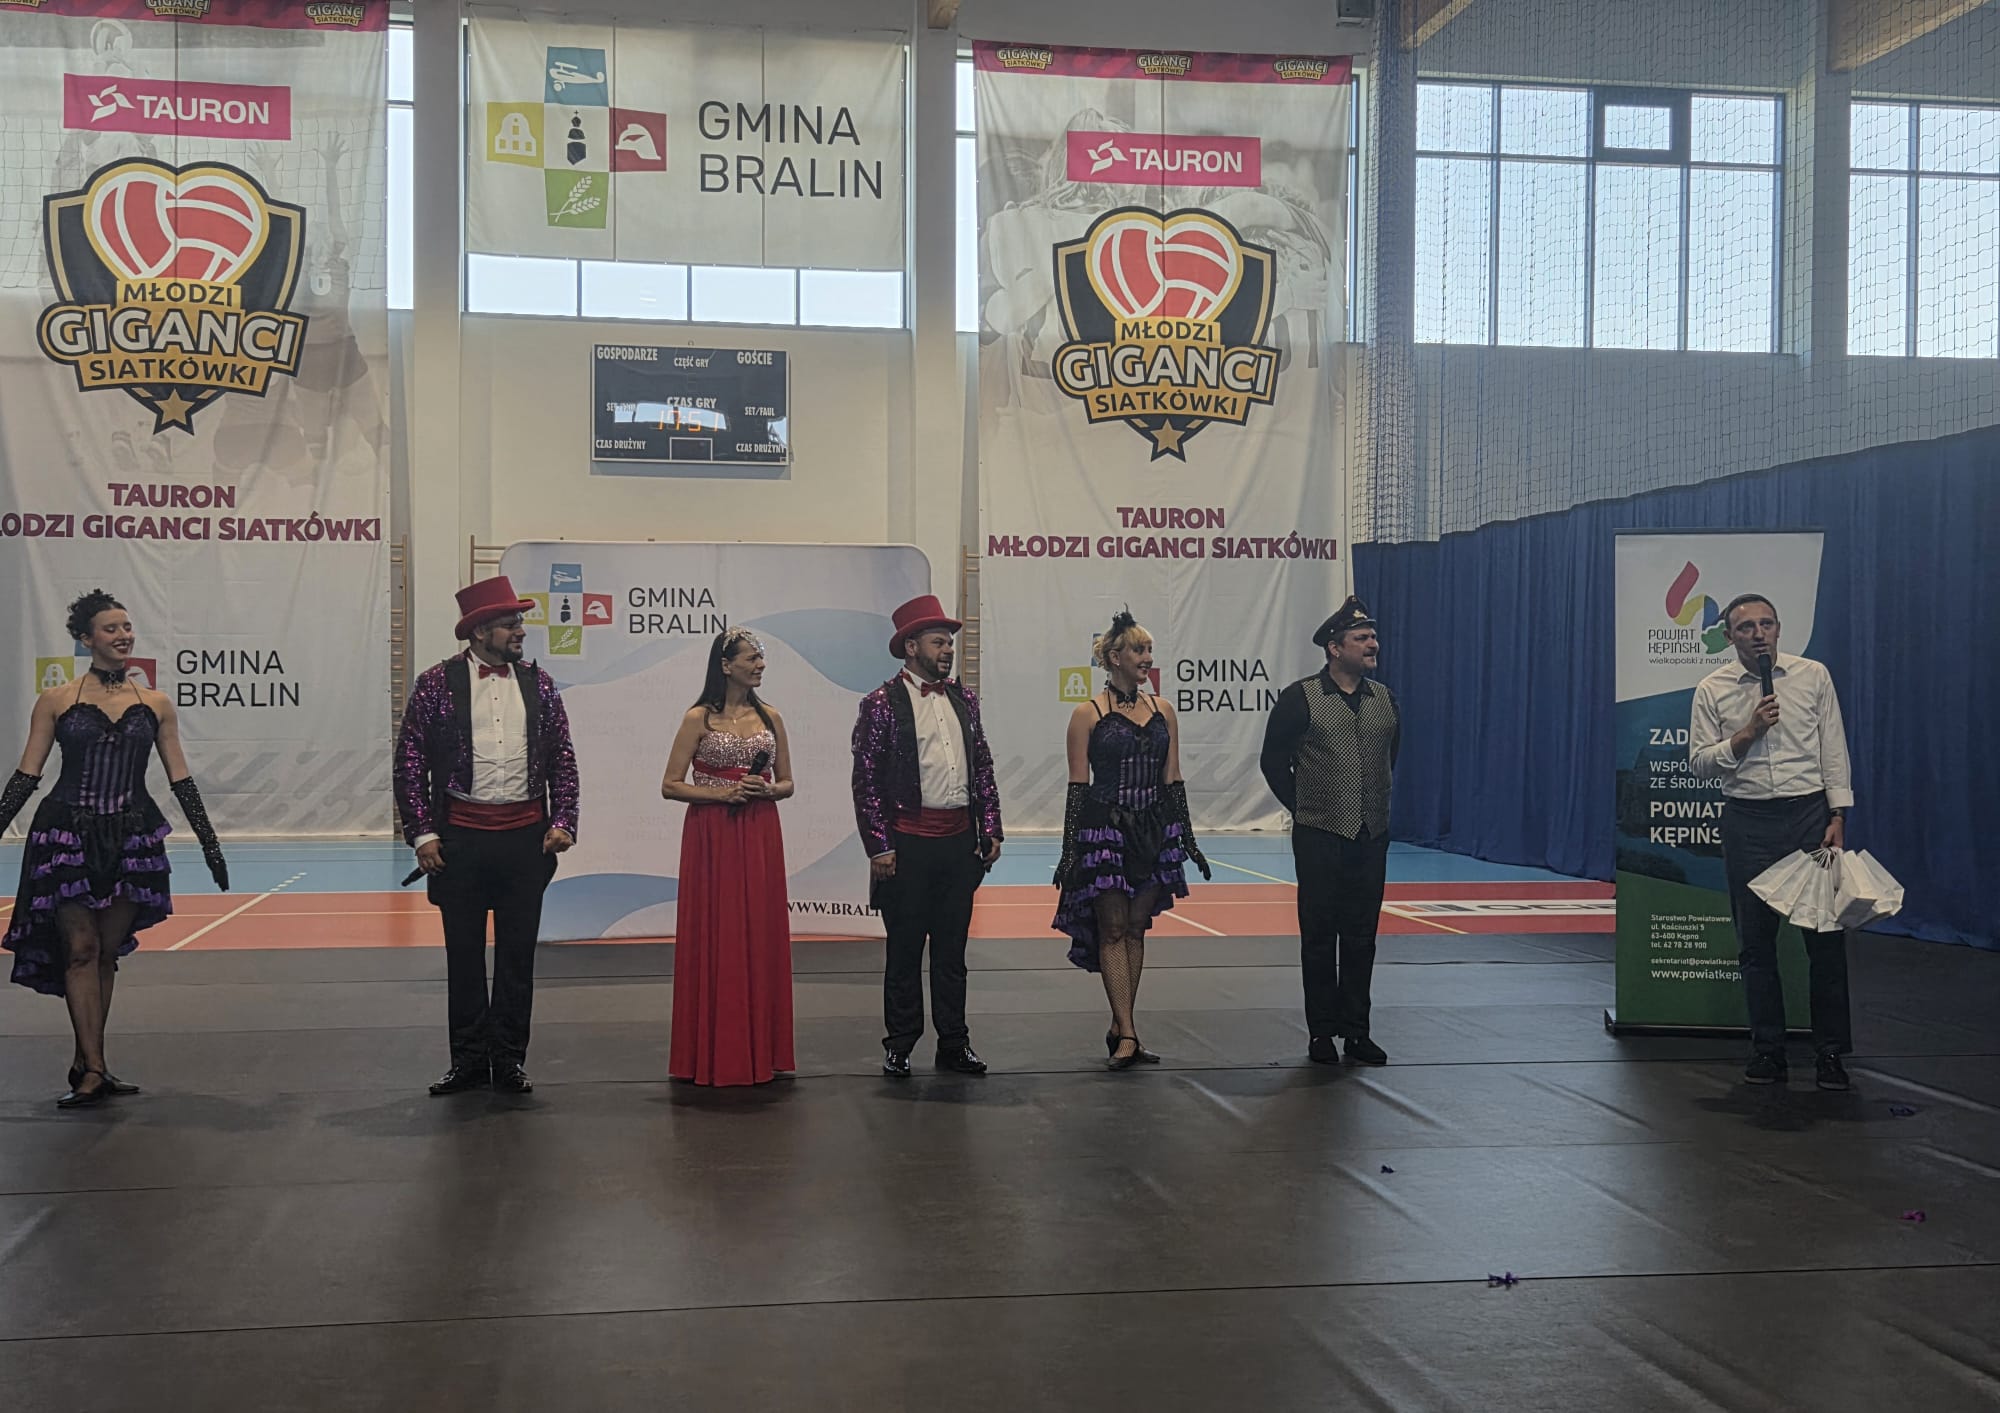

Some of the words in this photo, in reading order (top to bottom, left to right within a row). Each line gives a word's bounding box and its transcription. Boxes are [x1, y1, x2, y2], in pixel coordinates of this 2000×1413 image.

[307, 4, 364, 19] GIGANCI
[998, 49, 1051, 63] GIGANCI
[1138, 55, 1191, 69] GIGANCI
[1275, 60, 1327, 73] GIGANCI
[137, 95, 270, 125] TAURON
[698, 100, 861, 146] GMINA
[1129, 147, 1243, 173] TAURON
[699, 153, 883, 199] BRALIN
[123, 282, 233, 307] MŁODZI
[48, 308, 298, 364] GIGANCI
[1121, 320, 1213, 342] MŁODZI
[597, 347, 659, 361] GOSPODARZE
[673, 355, 694, 370] CZĘŚĆ
[695, 358, 709, 368] GRY
[737, 349, 773, 365] GOŚCIE
[90, 356, 257, 386] SIATKÓWKI
[1061, 346, 1271, 394] GIGANCI
[666, 397, 693, 409] CZAS
[696, 398, 717, 409] GRY
[744, 406, 775, 416] SET/FAUL
[1095, 389, 1238, 416] SIATKÓWKI
[595, 439, 613, 450] CZAS
[614, 438, 647, 450] DRUŻYNY
[736, 443, 753, 453] CZAS
[107, 483, 236, 508] TAURON
[1117, 506, 1225, 529] TAURON
[0, 512, 75, 538] ODZI
[82, 514, 211, 541] GIGANCI
[218, 511, 381, 542] SIATKÓWKI
[988, 535, 1090, 558] MŁODZI
[1096, 536, 1205, 559] GIGANCI
[1211, 530, 1337, 560] SIATKÓWKI
[628, 587, 716, 608] GMINA
[629, 613, 728, 634] BRALIN
[1648, 629, 1696, 642] POWIAT
[1648, 642, 1700, 655] KĘPIŃSKI
[176, 650, 285, 675] GMINA
[1649, 656, 1698, 665] wielkopolski
[1176, 659, 1270, 682] GMINA
[176, 682, 300, 708] BRALIN
[1177, 688, 1281, 712] BRALIN
[1649, 728, 1689, 745] ZAD
[1650, 777, 1667, 789] ZE
[1650, 801, 1726, 818] POWIAT
[1651, 914, 1687, 922] Starostwo
[1661, 923, 1699, 931] Kościuszki
[1700, 923, 1705, 931] 5
[1651, 932, 1676, 940] 63-600
[1677, 932, 1699, 941] Kępno
[1663, 941, 1672, 949] 62
[1674, 941, 1682, 949] 78
[1694, 942, 1707, 950] 900
